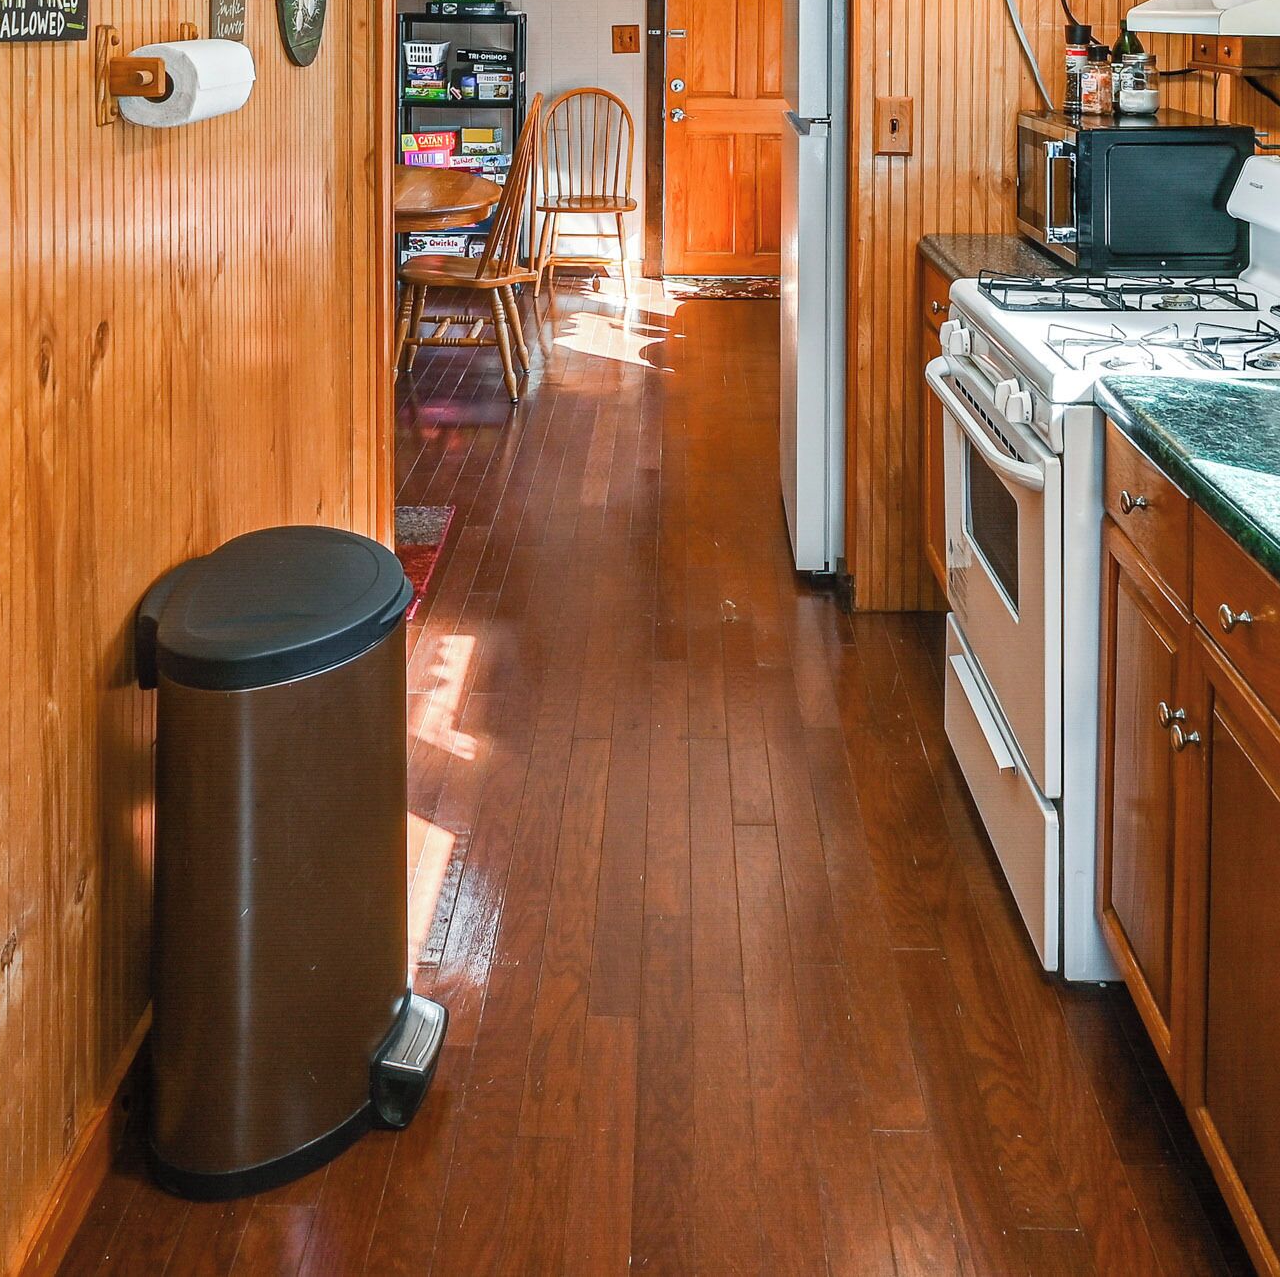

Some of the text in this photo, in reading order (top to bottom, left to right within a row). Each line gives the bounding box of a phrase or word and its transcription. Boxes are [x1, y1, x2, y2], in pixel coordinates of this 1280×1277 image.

[0, 10, 65, 38] ALLOWED
[468, 53, 507, 61] TRI-OMINOS
[418, 135, 443, 145] CATAN
